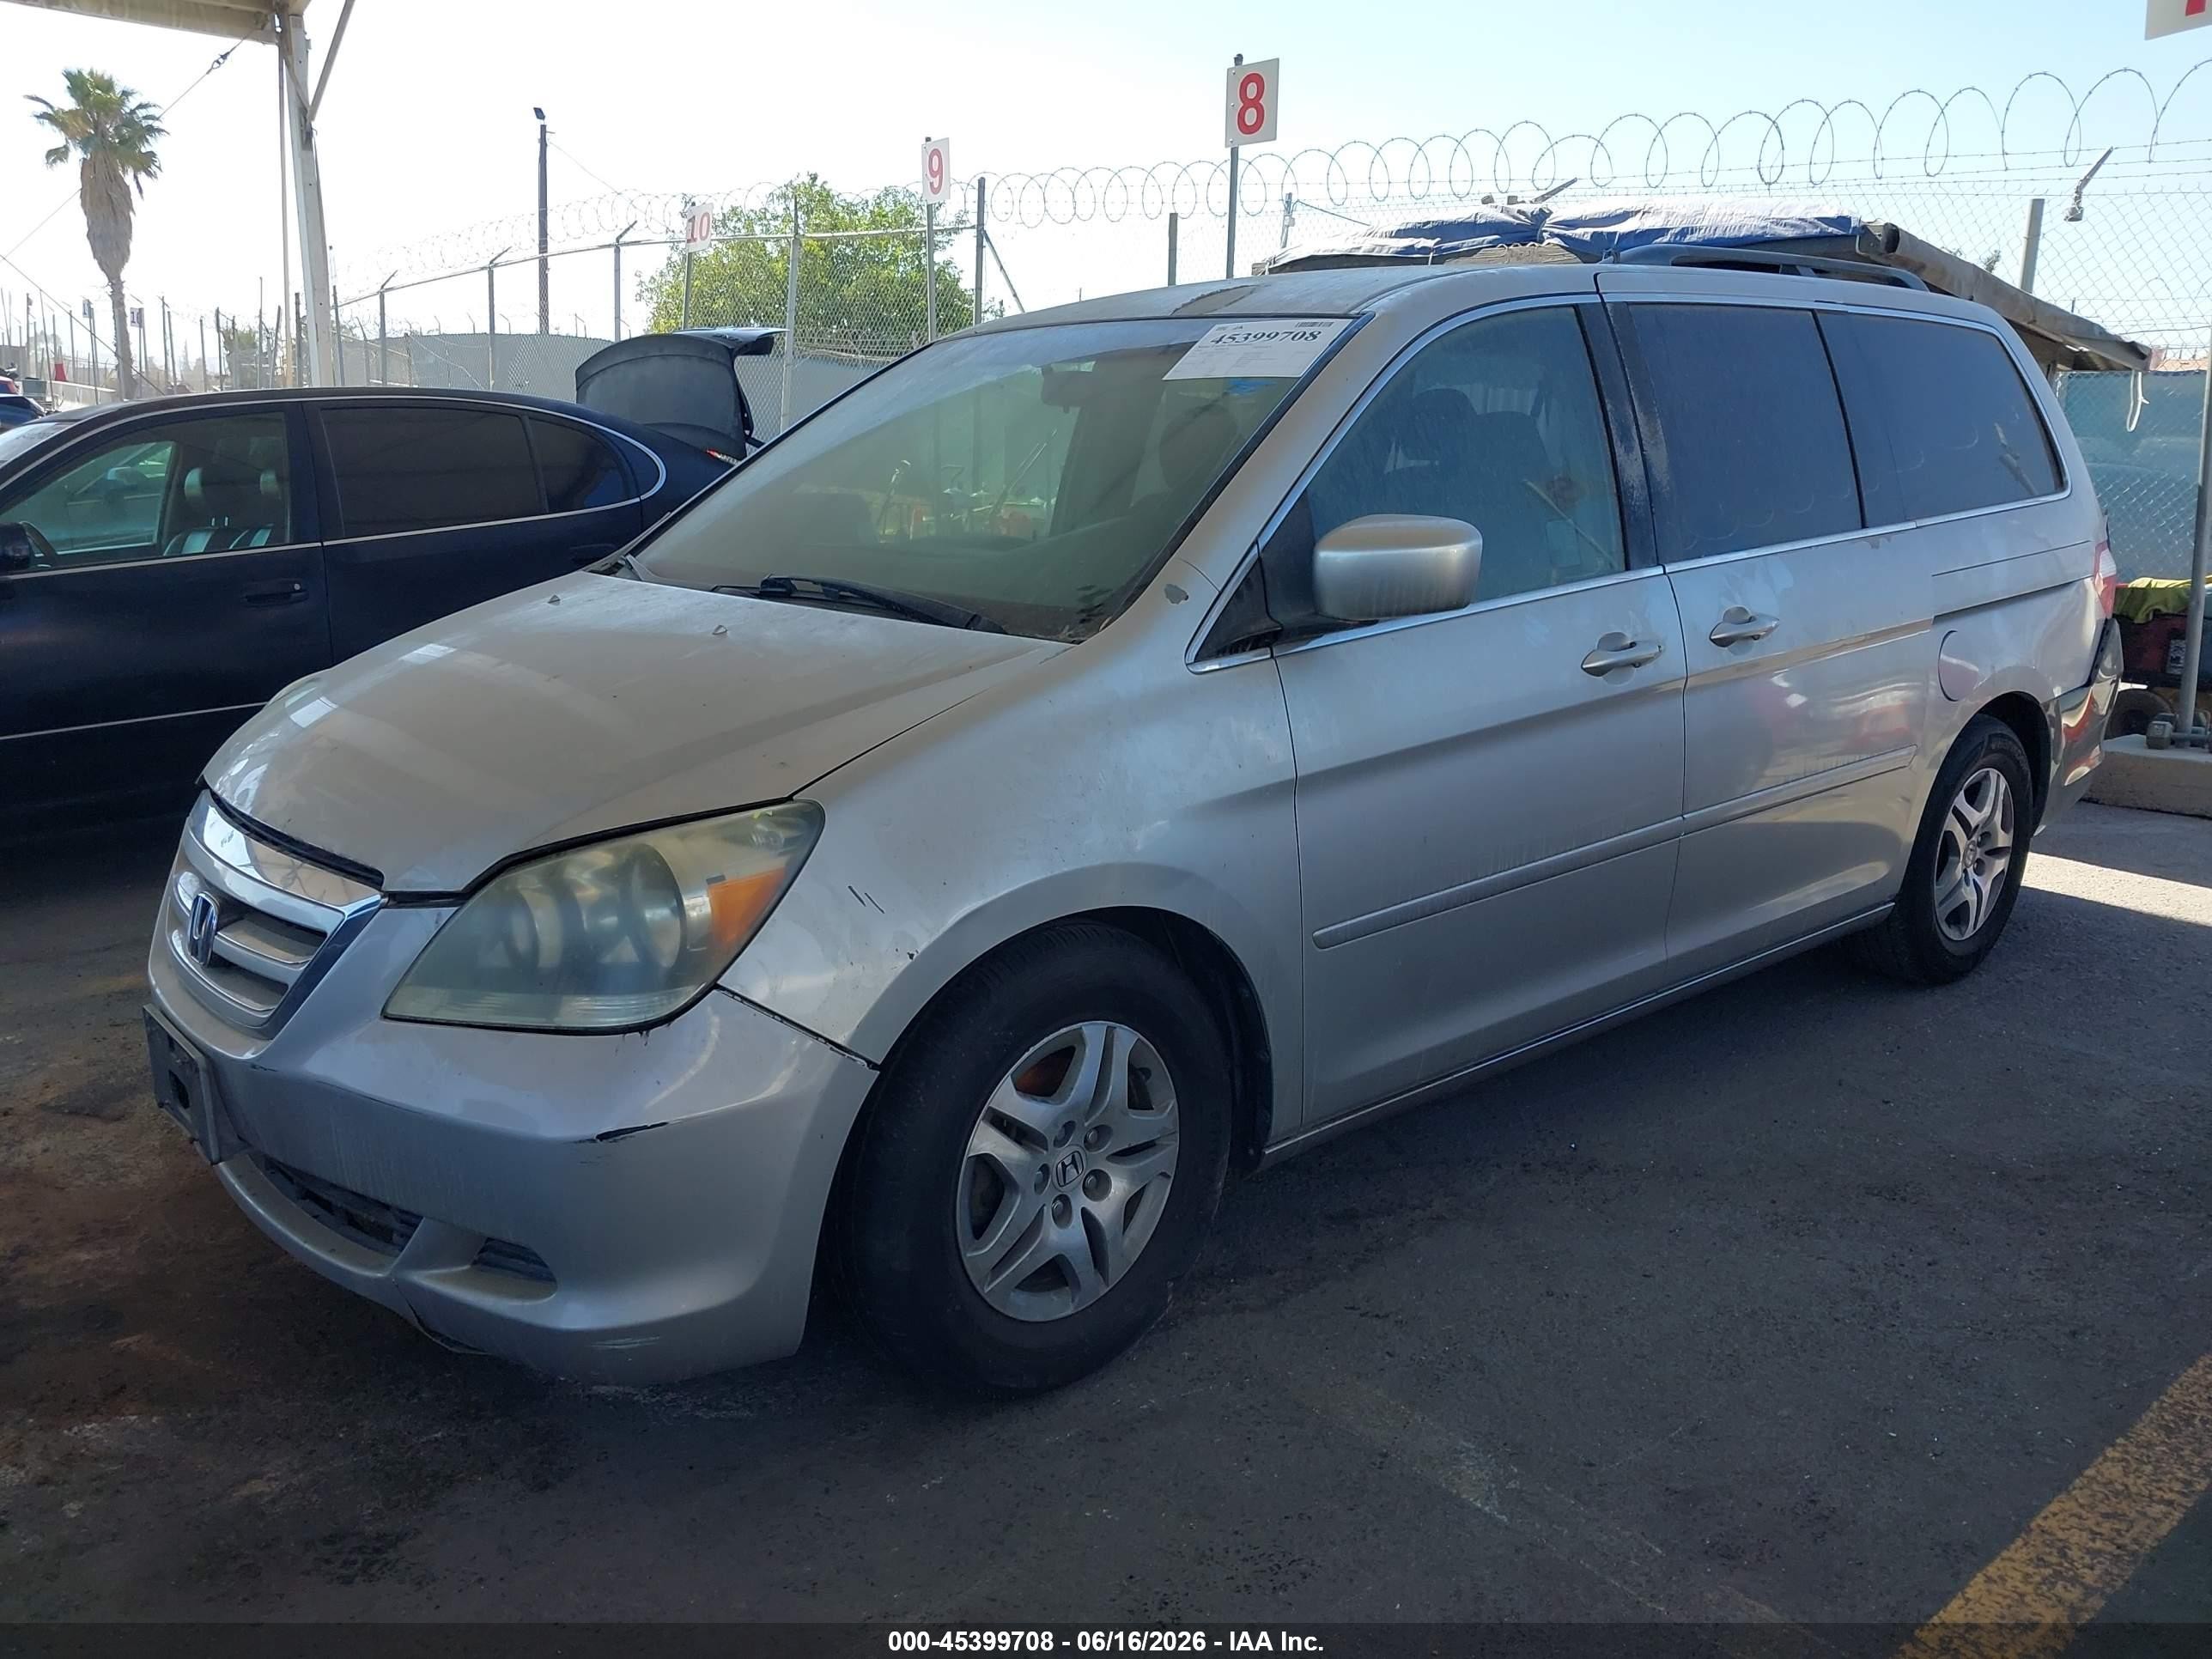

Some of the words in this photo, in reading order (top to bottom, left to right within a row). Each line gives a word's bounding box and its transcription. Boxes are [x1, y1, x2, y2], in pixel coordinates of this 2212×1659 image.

[1237, 72, 1265, 135] 8
[928, 148, 943, 195] 9
[687, 211, 710, 244] 10
[1210, 331, 1322, 344] 45399708
